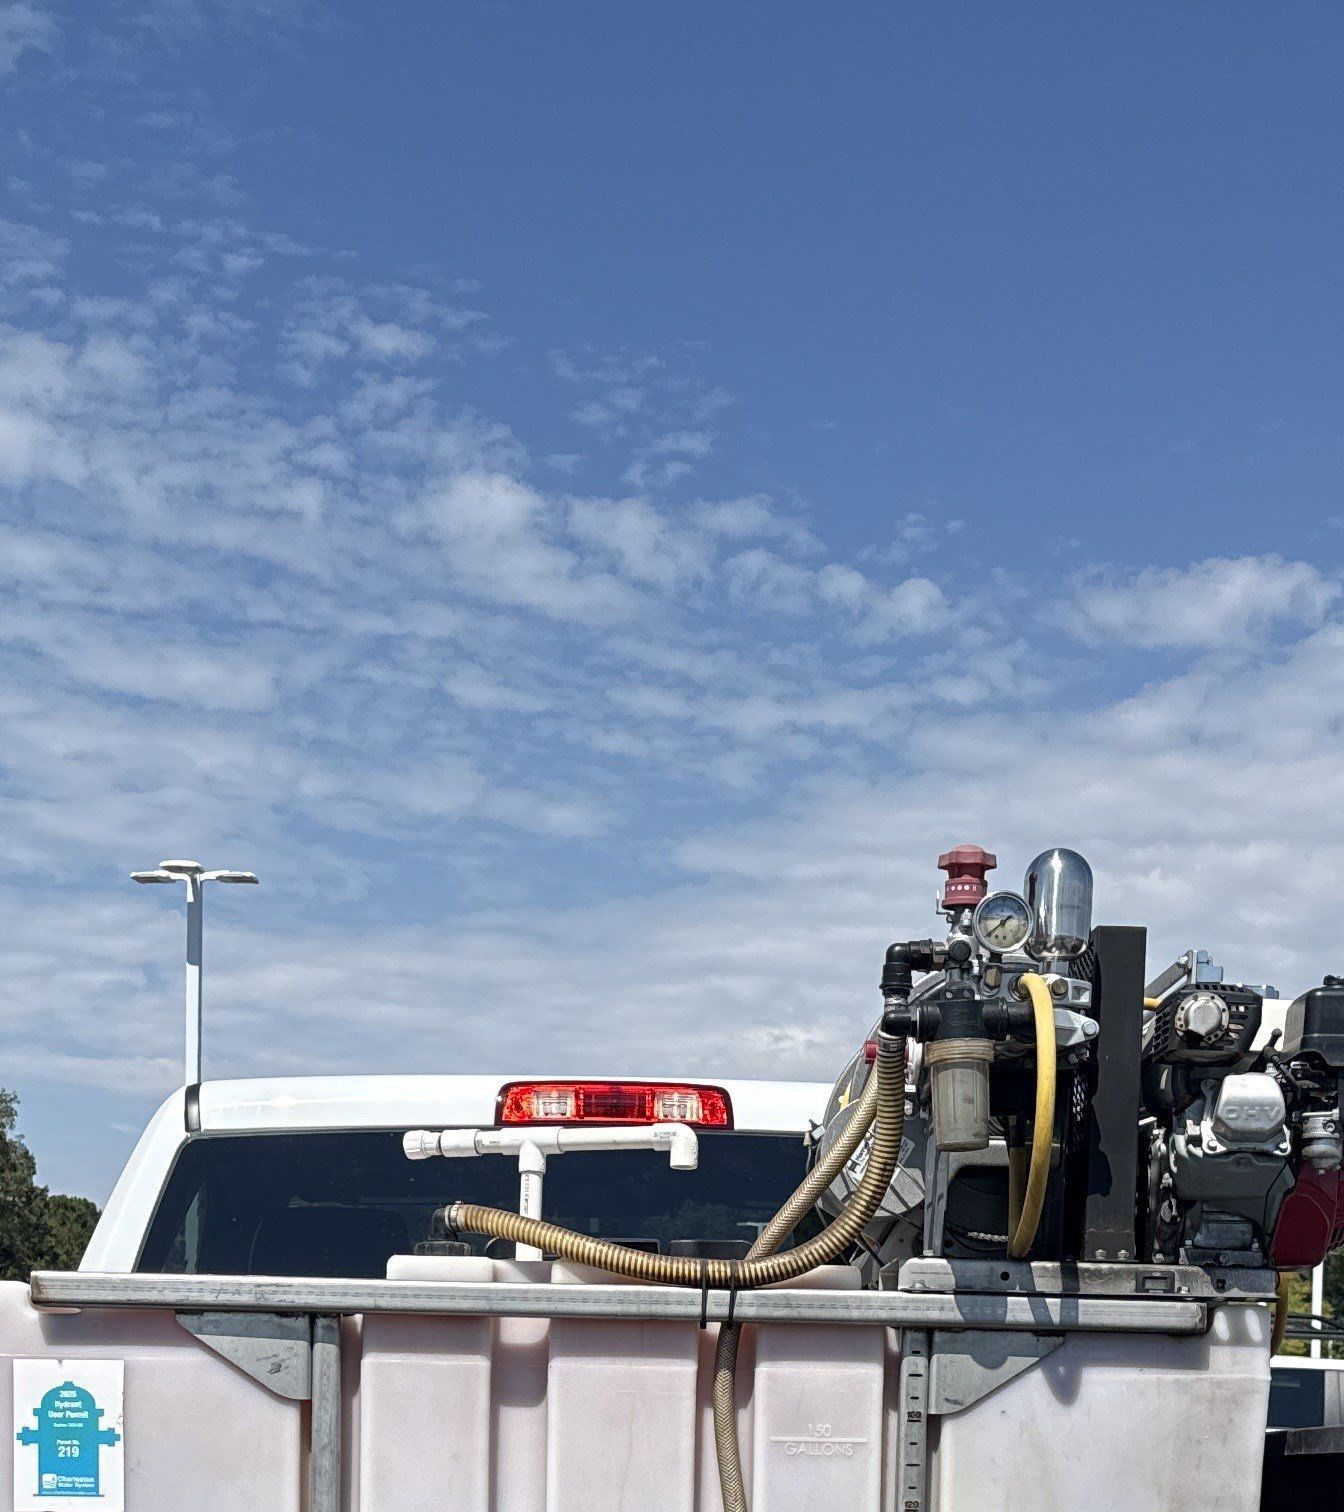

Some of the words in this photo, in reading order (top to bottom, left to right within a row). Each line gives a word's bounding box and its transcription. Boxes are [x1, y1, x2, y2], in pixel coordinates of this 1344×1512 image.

[1223, 1105, 1280, 1121] OHV
[47, 1410, 65, 1419] User
[65, 1410, 89, 1419] Permit
[808, 1424, 832, 1437] 150
[57, 1445, 80, 1458] 219
[784, 1442, 854, 1456] GALLONS
